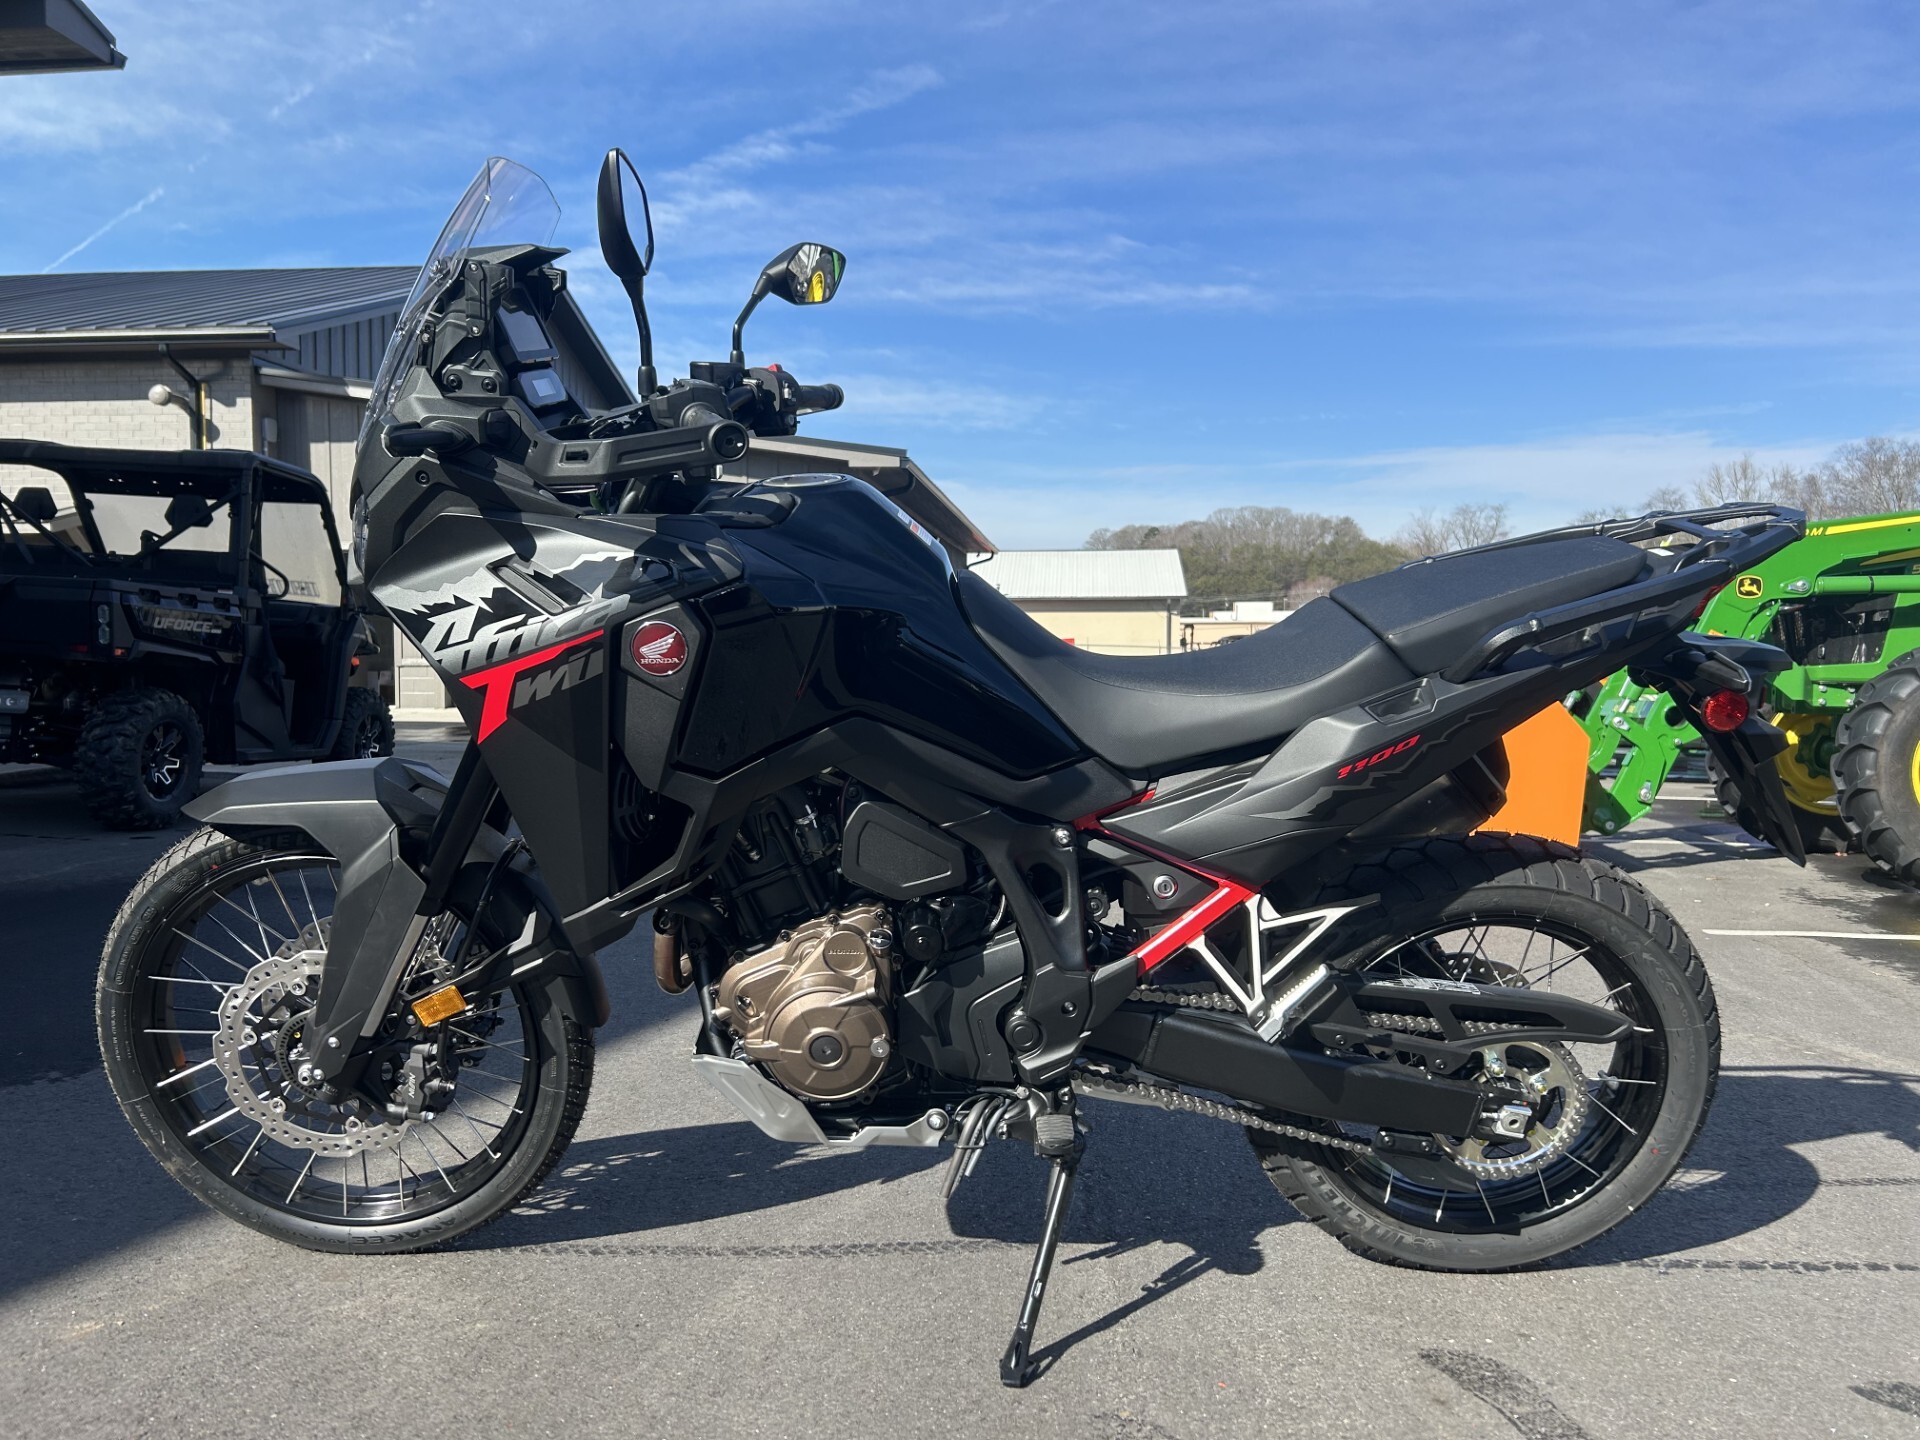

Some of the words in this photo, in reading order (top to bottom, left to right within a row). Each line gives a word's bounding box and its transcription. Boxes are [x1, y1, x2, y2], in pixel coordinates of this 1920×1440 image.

[153, 616, 213, 633] UFORCE
[640, 657, 680, 665] HONDA
[1337, 734, 1421, 779] 1100
[1301, 1164, 1405, 1249] MICHELI
[351, 1217, 457, 1245] ANAKEE
